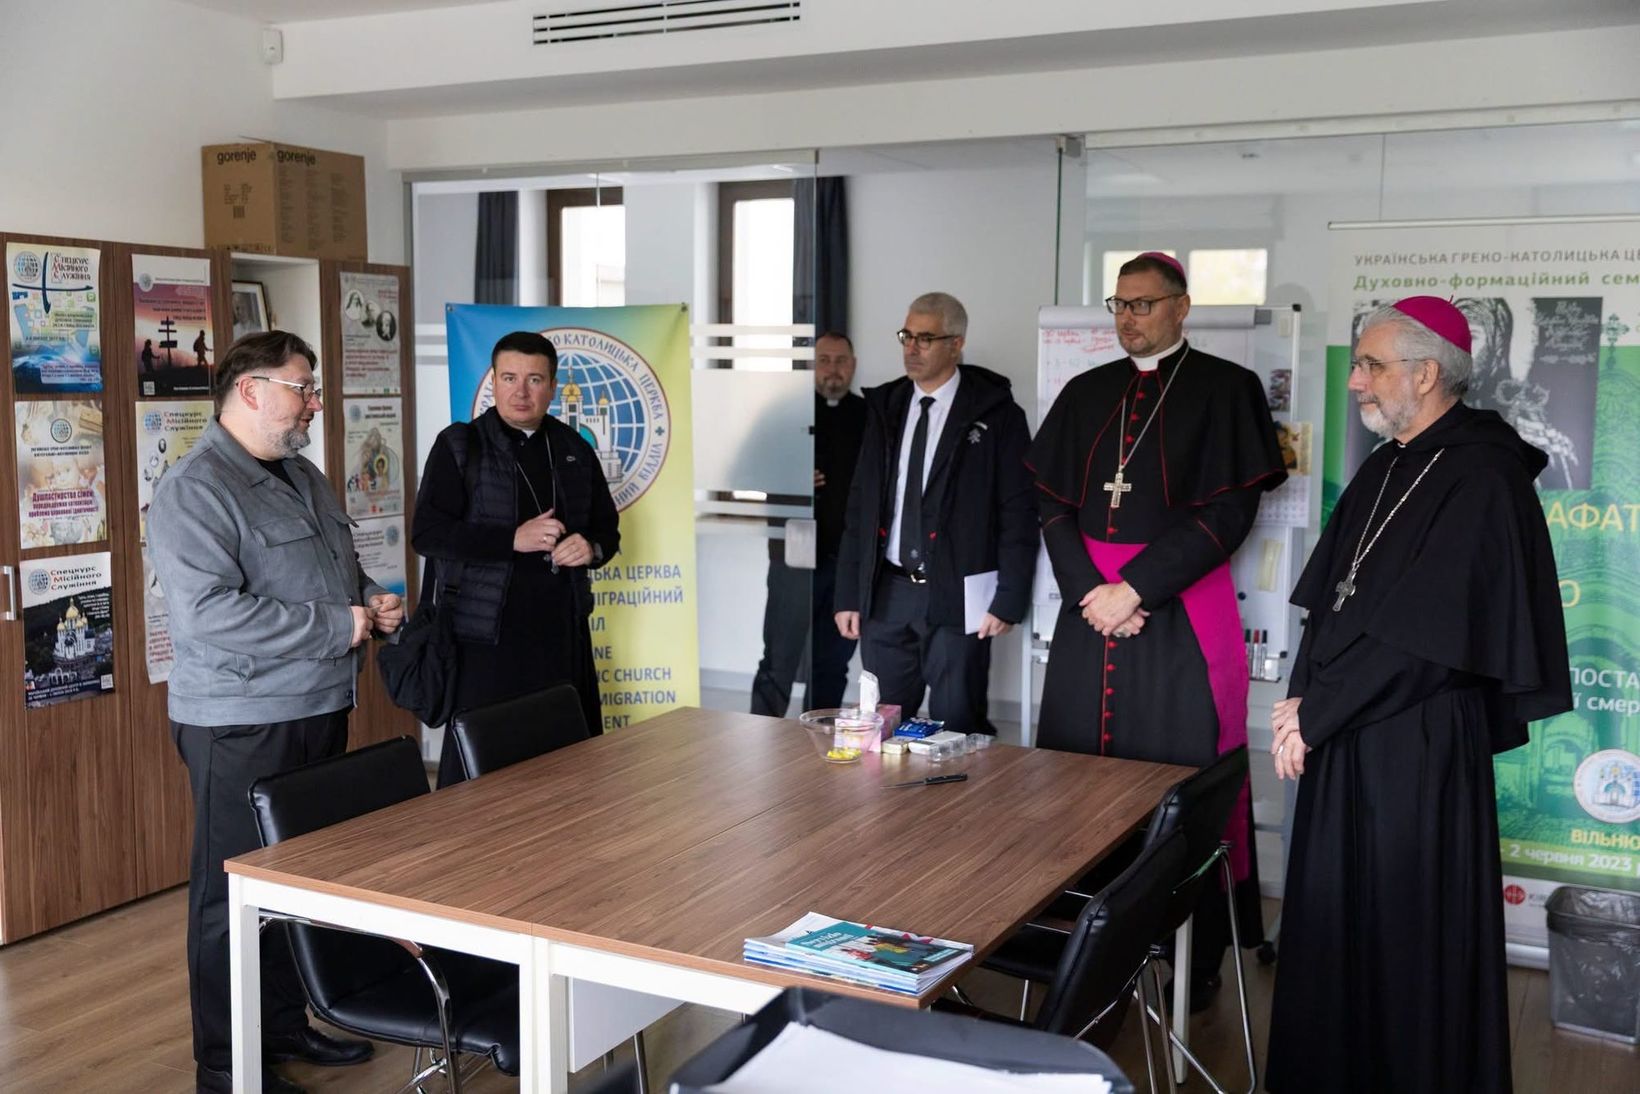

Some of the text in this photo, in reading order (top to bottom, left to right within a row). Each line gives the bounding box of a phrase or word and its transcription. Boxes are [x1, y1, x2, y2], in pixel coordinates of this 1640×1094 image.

[217, 150, 256, 165] gorenje
[277, 150, 316, 166] gorenje
[1354, 252, 1448, 267] УКРАЇНСЬКА
[1451, 250, 1619, 264] ГРЕКО-КАТОЛИЦЬКА
[1353, 272, 1590, 291] Духовно-формаційний
[639, 373, 665, 421] ЦЕРКВА
[1547, 502, 1640, 533] АФАТ
[50, 566, 97, 577] Спецкурс
[53, 571, 102, 582] Місійного
[626, 564, 681, 583] ЦЕРКВА
[51, 579, 97, 591] Служіння
[591, 617, 606, 632] ІЛ
[594, 646, 613, 660] NE
[598, 667, 672, 684] IC CHURCH
[605, 714, 631, 730] ENT
[1509, 843, 1520, 858] 2
[1524, 848, 1585, 866] червня
[1588, 853, 1633, 873] 2023
